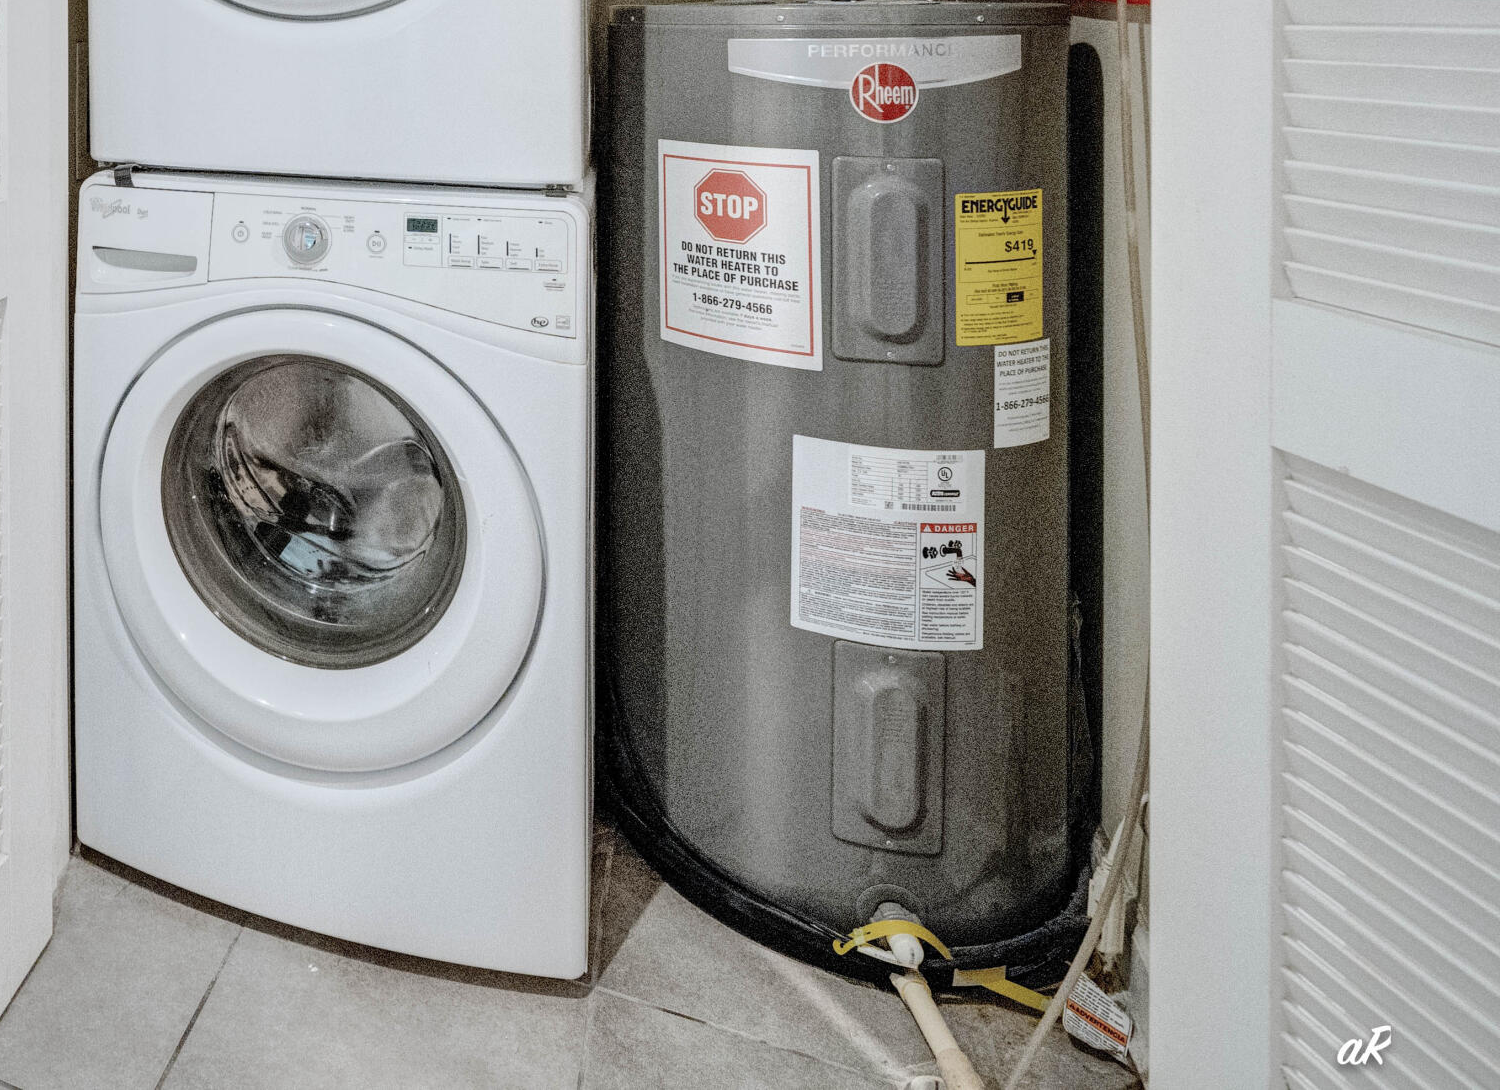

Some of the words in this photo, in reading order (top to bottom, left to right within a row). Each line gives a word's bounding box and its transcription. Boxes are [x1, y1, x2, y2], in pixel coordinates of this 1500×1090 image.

[858, 64, 915, 113] Rheem
[700, 191, 759, 220] STOP
[681, 241, 693, 252] DO
[695, 244, 714, 255] NOT
[716, 247, 757, 261] RETURN
[761, 252, 787, 264] THIS
[673, 263, 689, 275] THE
[691, 266, 720, 281] PLACE
[724, 272, 737, 283] OF
[740, 275, 799, 291] PURCHASE
[687, 254, 718, 268] WATER
[721, 258, 761, 274] HEATER
[765, 265, 779, 277] TO
[692, 292, 773, 314] 1-866-279-4566
[996, 359, 1016, 367] WATER
[1016, 357, 1035, 366] HEATER
[1008, 349, 1020, 357] NOT
[999, 369, 1016, 377] PLACE
[934, 524, 974, 532] DANGER
[1075, 1006, 1125, 1043] ADVERTENCIA
